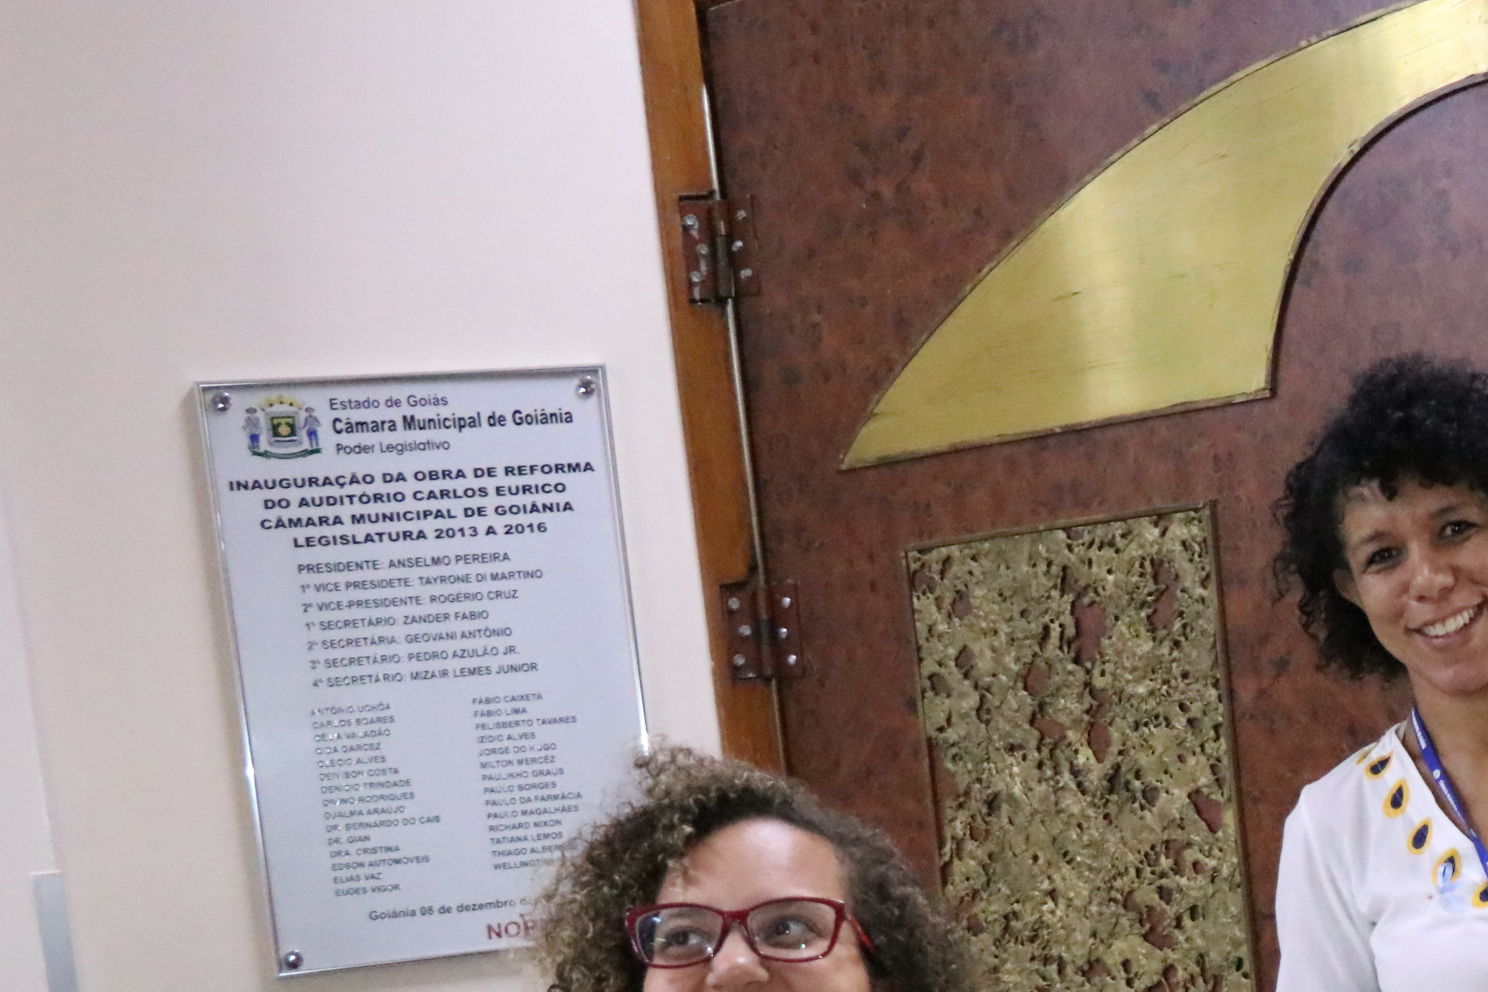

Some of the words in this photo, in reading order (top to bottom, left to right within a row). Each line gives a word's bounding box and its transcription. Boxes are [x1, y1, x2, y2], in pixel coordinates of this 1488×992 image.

[329, 397, 381, 411] Estado
[384, 396, 403, 408] de
[406, 394, 449, 407] Goiás
[331, 416, 398, 435] Câmara
[402, 412, 482, 433] Municipal
[486, 410, 508, 427] de
[511, 407, 574, 426] Goiânia
[336, 441, 376, 456] Poder
[380, 437, 451, 455] Legislativo
[228, 473, 376, 493] INAUGURAÇÃO
[381, 471, 408, 484] DA
[413, 468, 467, 482] OBRA
[473, 466, 498, 479] DE
[504, 461, 595, 477] REFORMA
[263, 498, 292, 510] DO
[297, 490, 407, 508] AUDITÓRIO
[412, 487, 489, 501] CARLOS
[495, 482, 567, 497] EURICO
[259, 514, 345, 530] CÂMARA
[350, 508, 458, 525] MUNICIPAL
[463, 506, 488, 518] DE
[494, 500, 575, 516] GOIÂNIA
[293, 530, 428, 548] LEGISLATURA
[434, 526, 479, 539] 2013
[484, 525, 498, 536] A
[503, 522, 548, 535] 2016
[297, 559, 385, 575] PRESIDENTE:
[388, 555, 452, 569] ANSELMO
[455, 552, 511, 565] PEREIRA
[314, 582, 341, 593] VICE
[418, 573, 472, 586] TAYRONE
[476, 573, 487, 583] DI
[490, 569, 543, 582] MARTINO
[486, 589, 519, 601] CRUZ
[402, 613, 451, 625] ZANDER
[404, 631, 458, 644] GEOVANI
[407, 650, 450, 662] PEDRO
[410, 669, 450, 681] MIZAIR
[453, 666, 492, 678] LEMES
[495, 663, 539, 675] JUNIOR
[536, 716, 578, 726] TAVARES
[506, 732, 536, 741] ALVES
[483, 785, 515, 795] PAULO
[486, 798, 517, 807] PAULO
[402, 818, 416, 826] DO
[489, 822, 531, 833] RICHARD
[534, 820, 562, 829] NIXON
[490, 835, 529, 845] TATIANA
[532, 832, 564, 842] LEMOS
[492, 848, 528, 858] THIAGO
[368, 907, 417, 921] Goiânia
[420, 906, 435, 916] 08
[438, 905, 453, 915] de
[456, 899, 516, 913] dezembro
